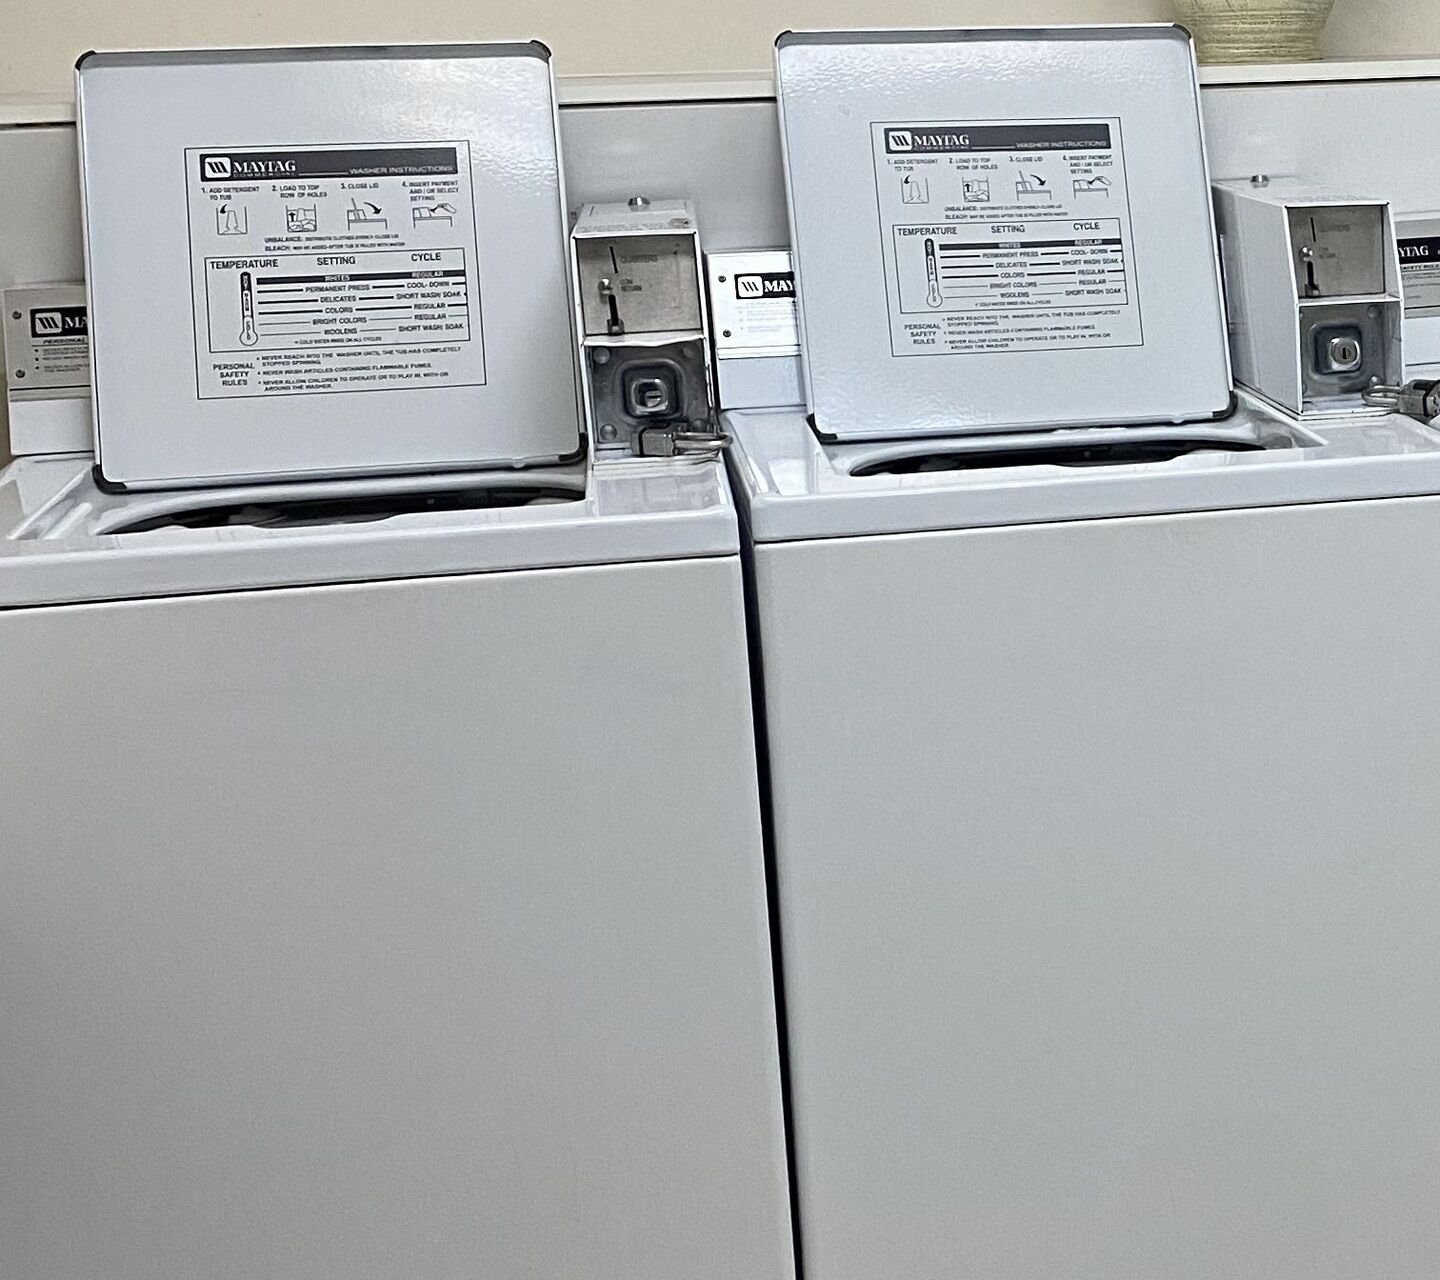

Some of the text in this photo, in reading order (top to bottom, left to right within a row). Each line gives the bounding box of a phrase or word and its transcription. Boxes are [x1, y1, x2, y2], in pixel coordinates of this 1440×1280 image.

[913, 134, 970, 147] MAYTAG
[1051, 140, 1107, 148] INSTRUCTIONS
[233, 160, 296, 173] MAYTAG
[349, 165, 453, 175] WASHER INSTRUCTIONS
[897, 222, 1100, 236] TEMPERATURE SETTING CYCLE
[210, 252, 441, 270] TEMPERATURE SETTING CYCLE
[320, 295, 356, 303] DELICATES
[397, 292, 419, 300] SHORT
